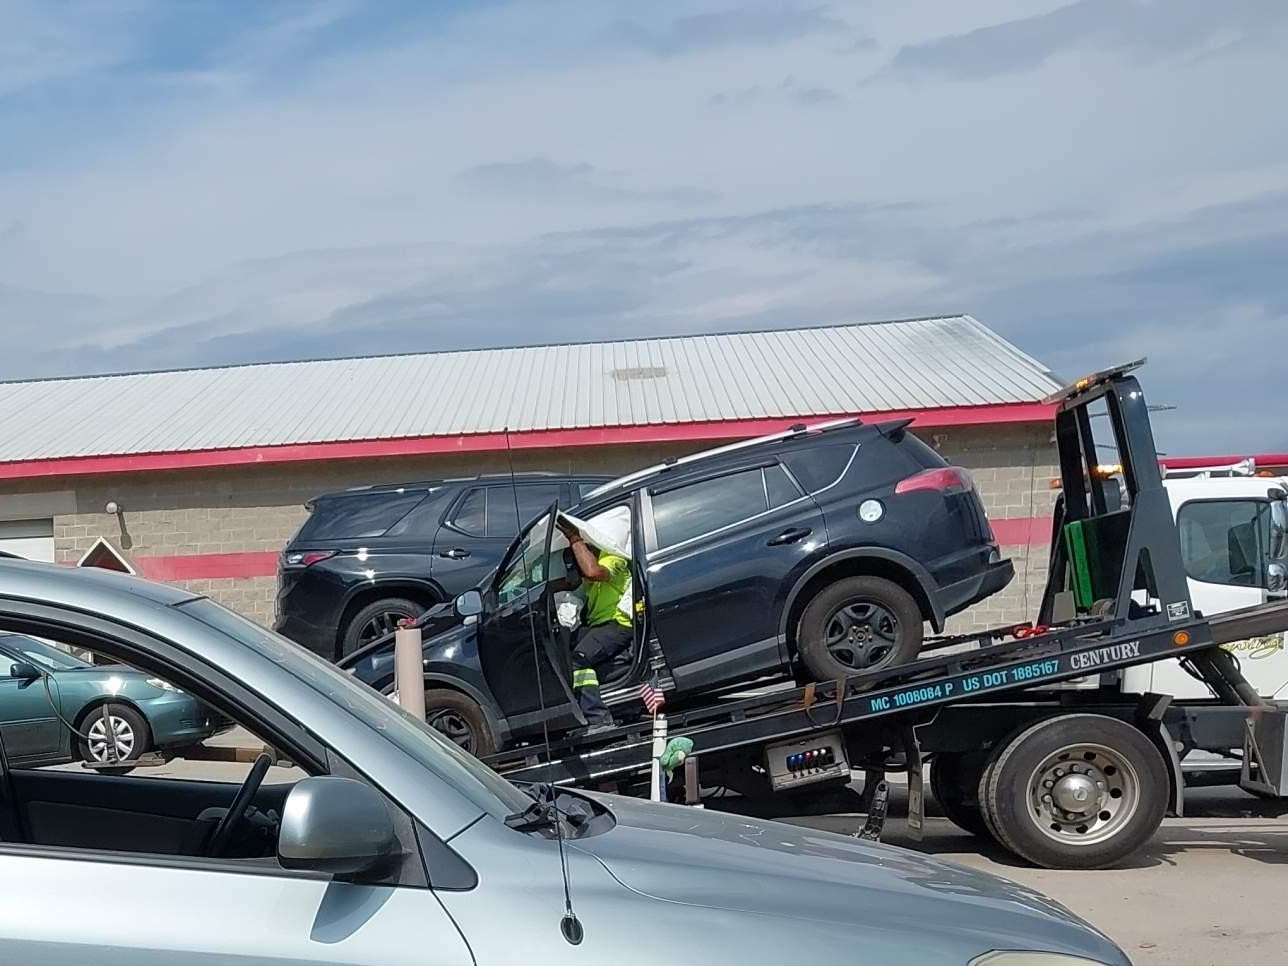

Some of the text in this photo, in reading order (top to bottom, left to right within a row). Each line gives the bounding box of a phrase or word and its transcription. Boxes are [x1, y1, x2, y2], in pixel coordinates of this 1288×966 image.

[1070, 641, 1142, 670] CENTURY
[871, 660, 1060, 711] MC 1008084 P US DOT 1885167
